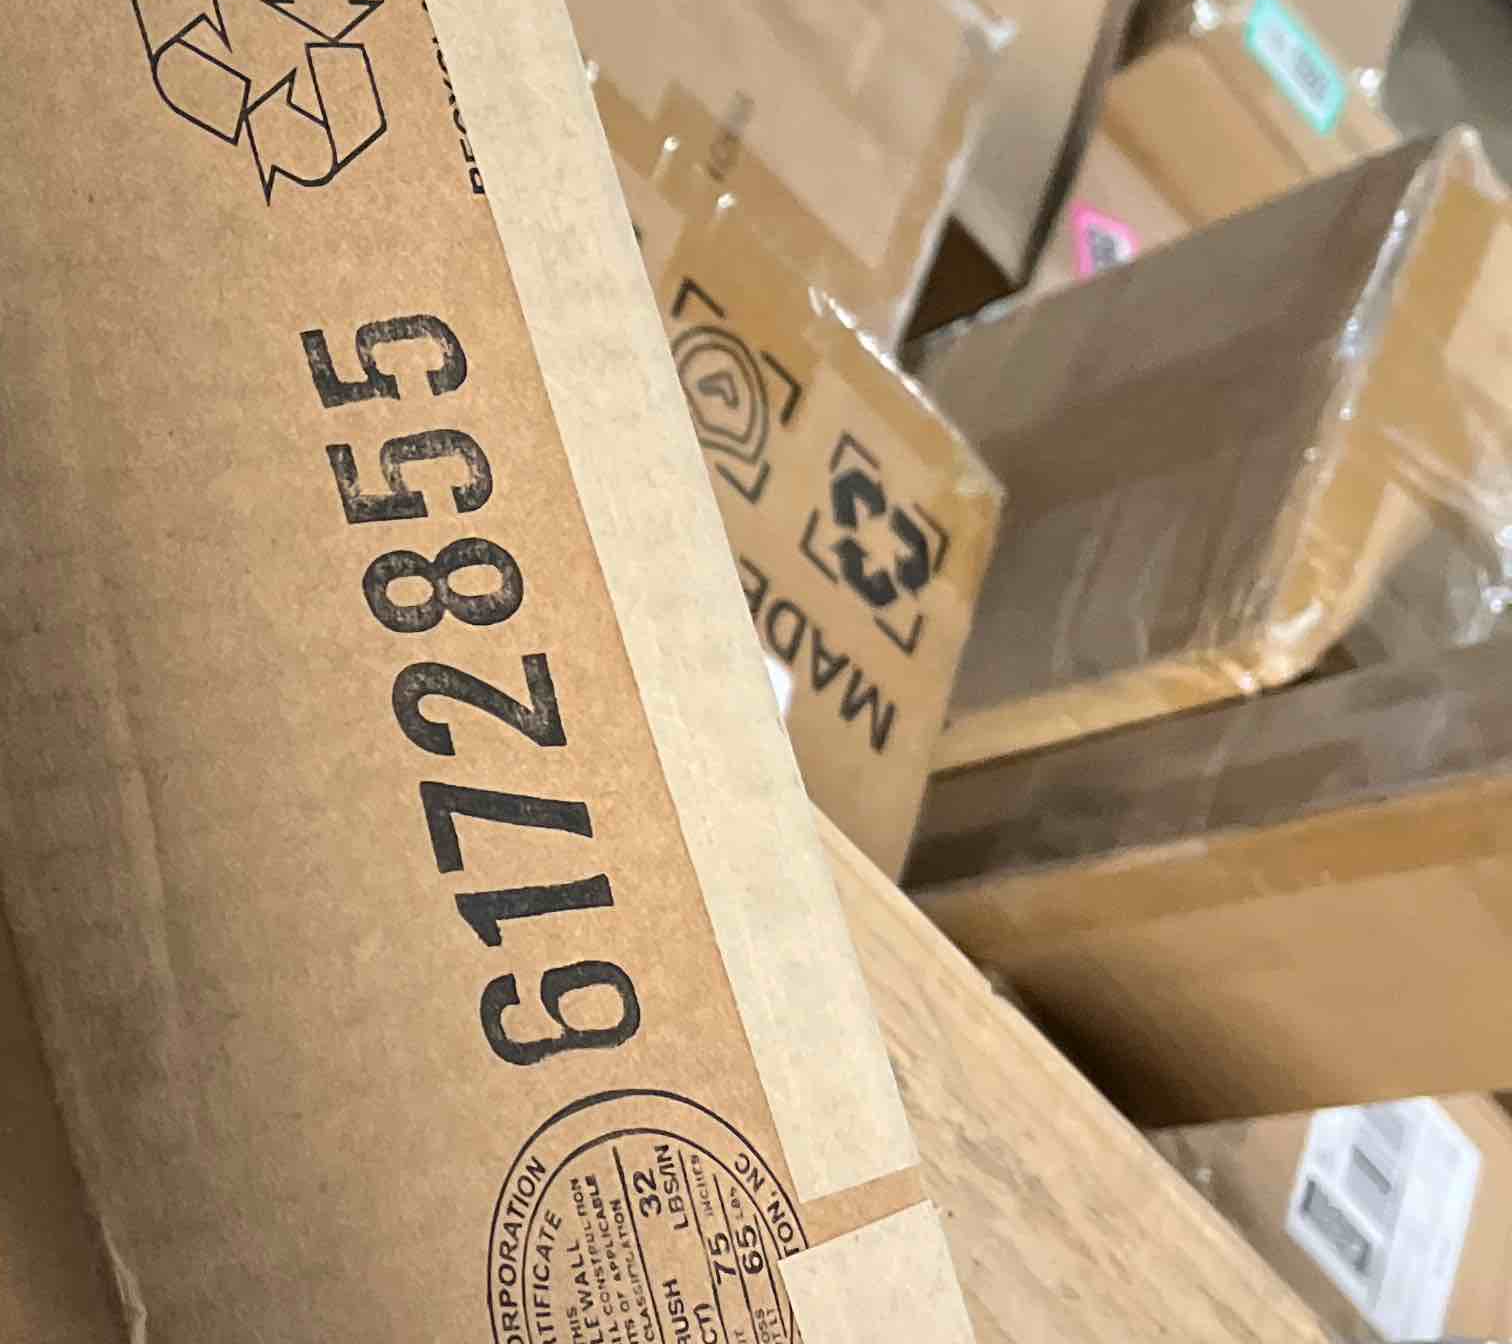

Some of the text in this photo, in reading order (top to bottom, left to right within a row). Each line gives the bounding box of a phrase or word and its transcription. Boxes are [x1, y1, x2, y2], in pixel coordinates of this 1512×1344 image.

[301, 312, 641, 1067] 6172855
[633, 1167, 662, 1218] 32
[654, 1144, 689, 1231] LBS/IN
[734, 1152, 766, 1192] NC
[567, 1238, 598, 1310] WALL
[708, 1232, 737, 1286] 75
[737, 1224, 764, 1275] 65
